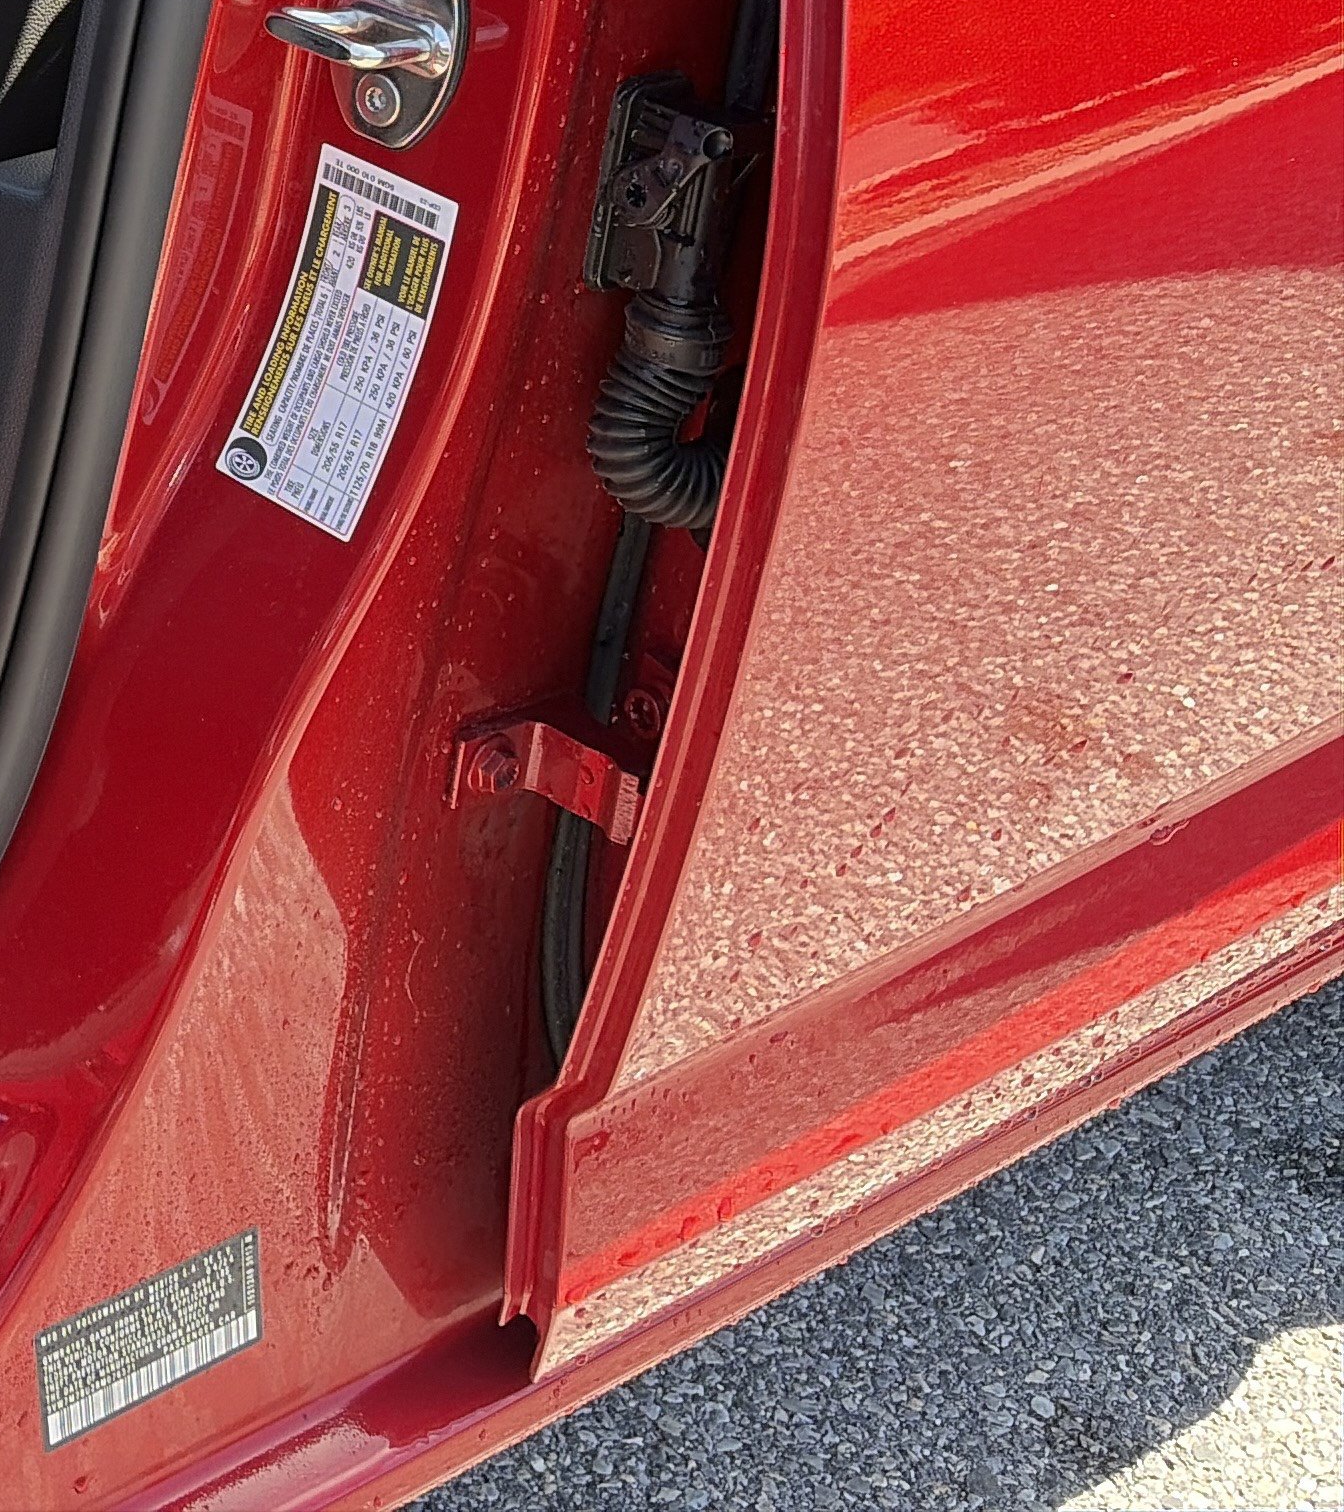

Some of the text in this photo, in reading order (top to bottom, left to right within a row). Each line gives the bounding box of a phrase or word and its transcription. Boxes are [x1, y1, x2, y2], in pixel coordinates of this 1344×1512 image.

[343, 203, 351, 212] 3
[412, 234, 420, 246] DE
[419, 236, 430, 256] PLUS
[332, 249, 340, 257] 2
[373, 228, 394, 286] FOR ADDITIONAL
[382, 236, 401, 286] INFORMATION
[414, 254, 425, 276] POUR
[250, 190, 338, 436] RENSEIGNEMENTS SUR LES PNEUS ET LE CHARGEMENT
[313, 297, 326, 318] TOTAL
[304, 317, 319, 343] PLACES
[242, 269, 308, 431] TIRE AND LOADING INFORMATION
[300, 342, 311, 354] DE
[353, 374, 365, 393] 250
[360, 353, 373, 373] KPA
[367, 344, 377, 353] /
[374, 313, 385, 329] PSI
[375, 361, 388, 381] KPA
[382, 352, 392, 360] /
[390, 321, 400, 337] PSI
[384, 390, 397, 410] 420
[391, 369, 404, 390] KPA
[399, 361, 408, 369] /
[406, 329, 417, 345] PSI
[265, 413, 283, 442] SEATING
[334, 420, 348, 440] R17
[349, 428, 364, 448] R17
[218, 1308, 235, 1326] CAR
